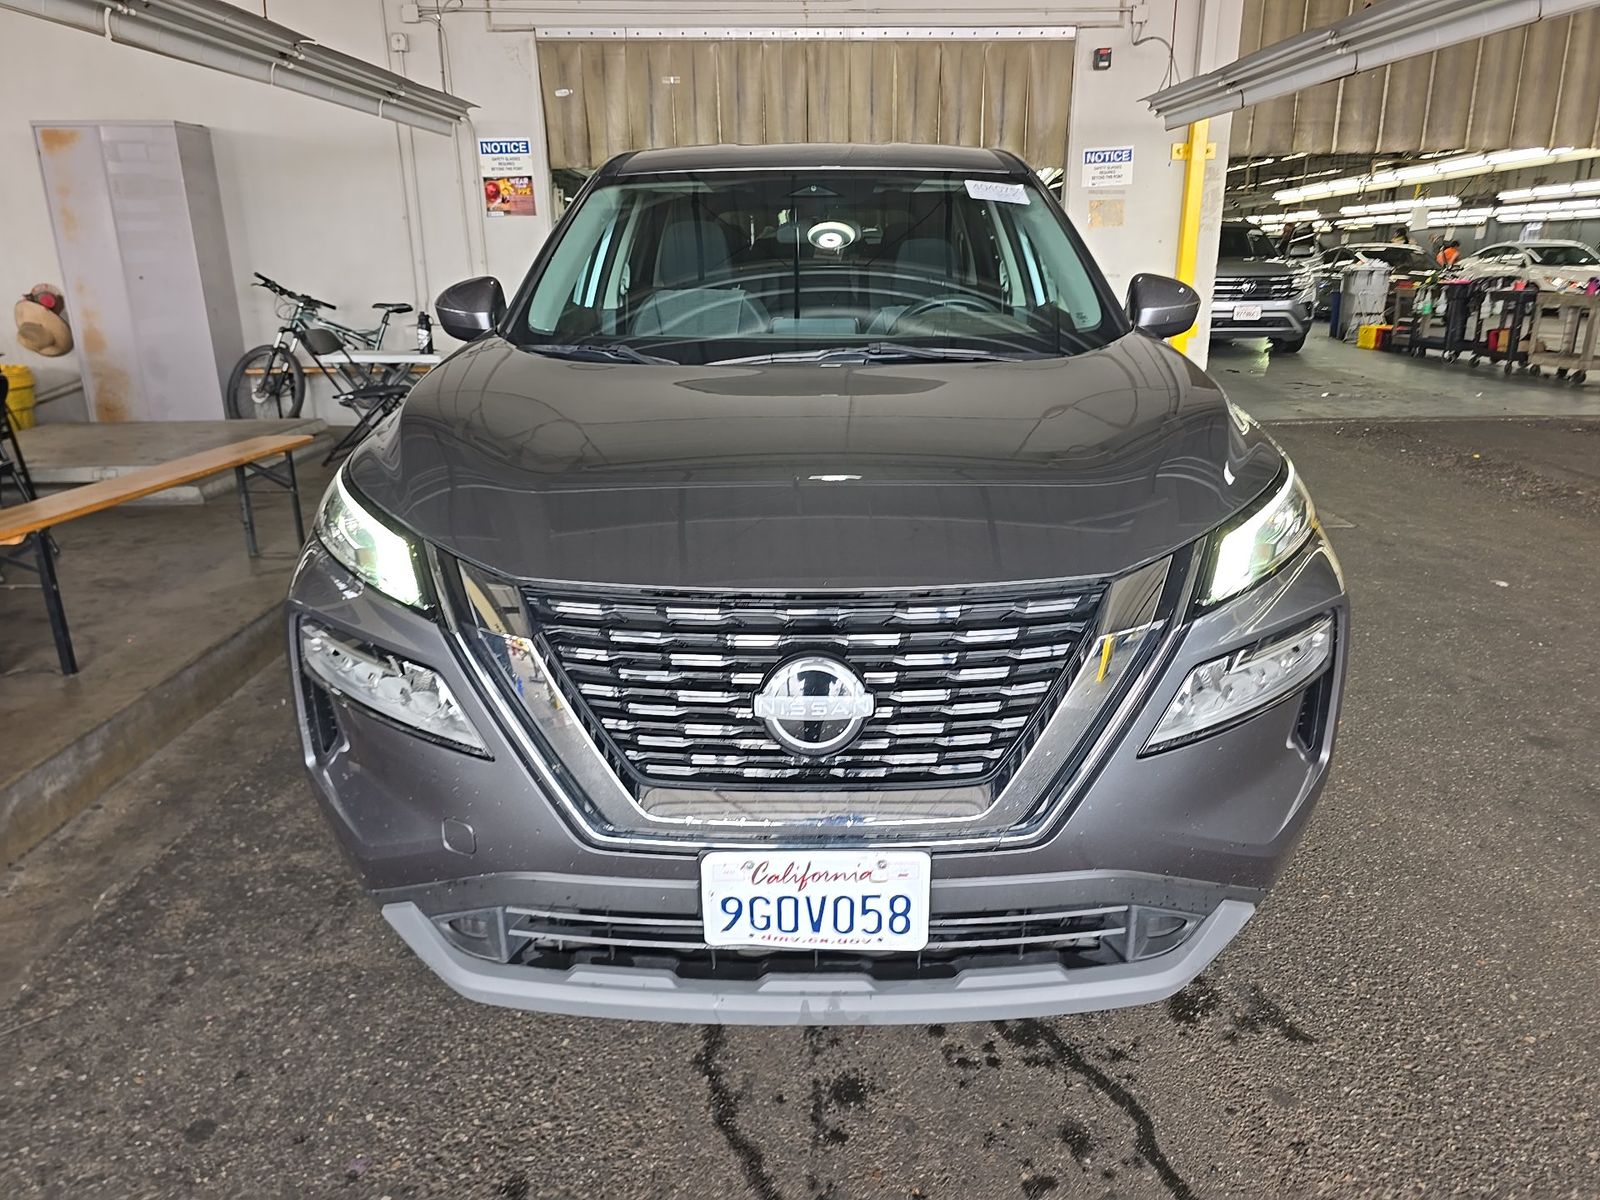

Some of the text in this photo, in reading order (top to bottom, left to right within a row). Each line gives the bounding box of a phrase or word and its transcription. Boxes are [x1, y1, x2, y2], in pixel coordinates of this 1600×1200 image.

[482, 142, 527, 153] NOTICE
[1086, 150, 1131, 163] NOTICE
[760, 701, 871, 716] NISSAN
[751, 860, 873, 892] California
[721, 894, 912, 935] 9GOV058
